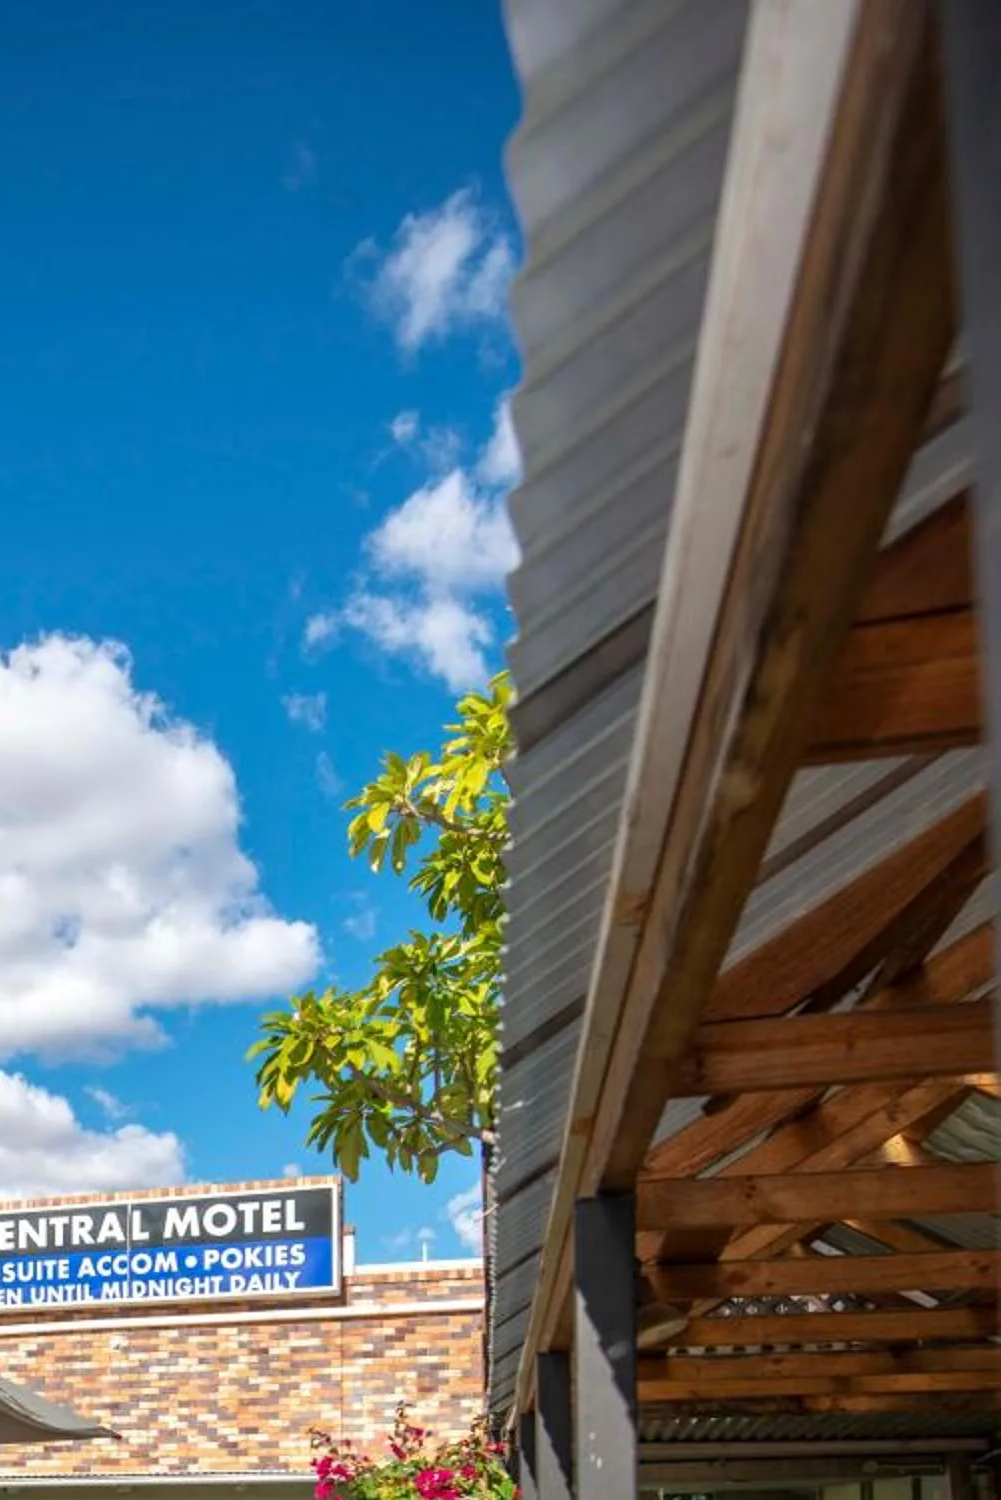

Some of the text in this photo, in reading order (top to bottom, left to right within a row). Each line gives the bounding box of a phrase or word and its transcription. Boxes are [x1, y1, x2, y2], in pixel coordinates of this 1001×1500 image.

[163, 1199, 306, 1238] MOTEL
[77, 1251, 178, 1278] ACCOM
[203, 1243, 306, 1270] POKIES
[30, 1283, 93, 1304] UNTIL
[101, 1275, 224, 1300] MIDNIGHT
[229, 1271, 301, 1293] DAILY
